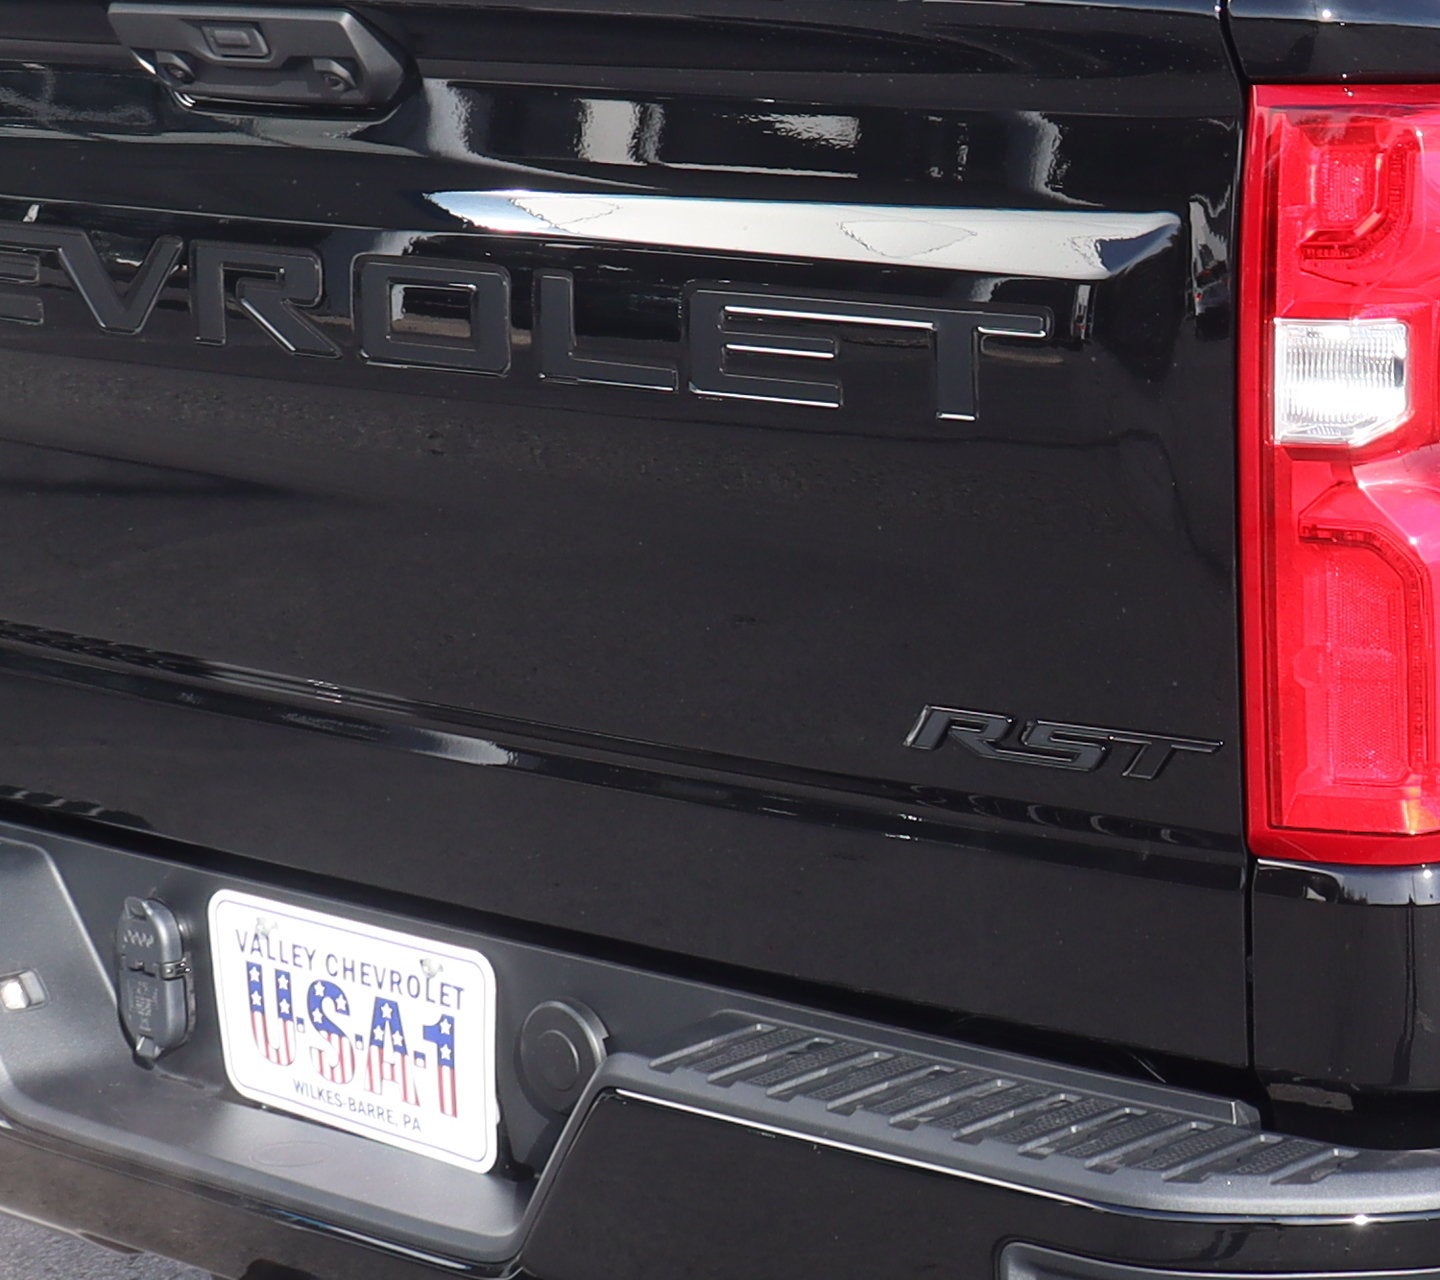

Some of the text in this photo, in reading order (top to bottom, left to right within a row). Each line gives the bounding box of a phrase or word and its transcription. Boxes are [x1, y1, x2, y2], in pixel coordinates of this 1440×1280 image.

[903, 703, 1224, 780] RST
[235, 928, 464, 1010] VALLEY CHEVROLET
[403, 1114, 422, 1133] PA
